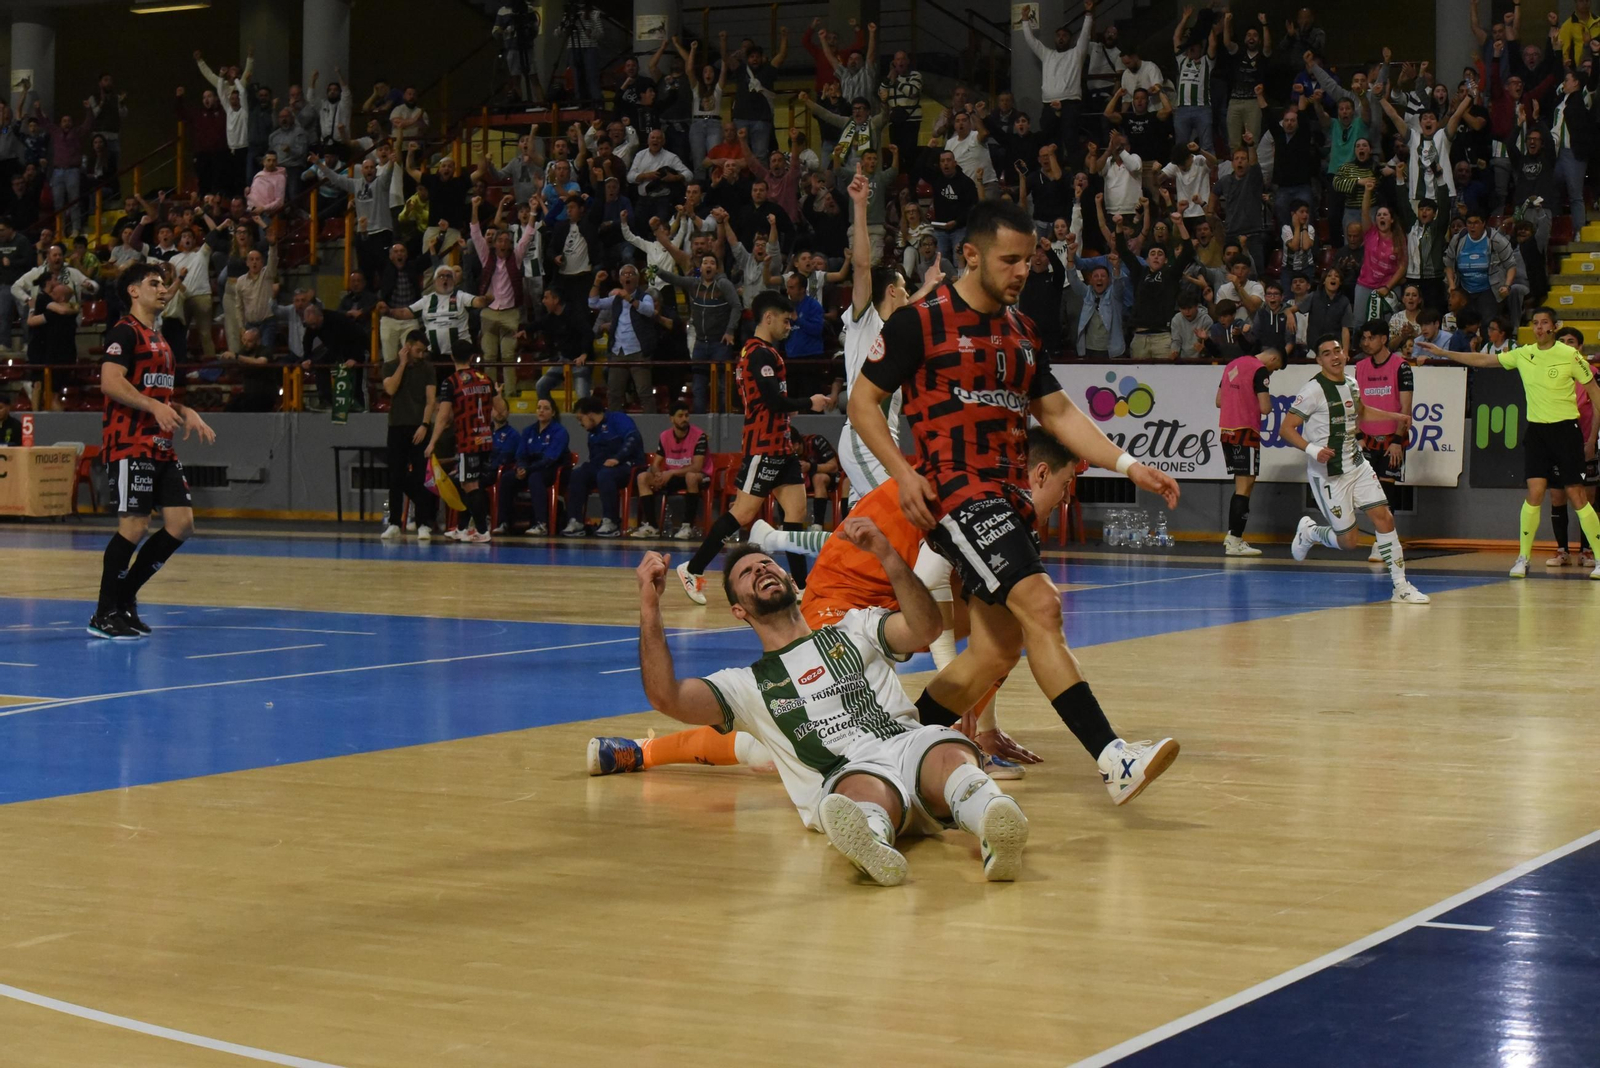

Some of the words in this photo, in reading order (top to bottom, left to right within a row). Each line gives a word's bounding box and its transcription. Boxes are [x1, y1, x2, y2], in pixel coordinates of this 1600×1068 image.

[996, 351, 1008, 382] 9
[477, 397, 486, 423] 4
[22, 416, 34, 435] 5
[1440, 443, 1456, 452] S.L.
[1324, 484, 1333, 500] 7
[976, 519, 1016, 550] Natural
[811, 680, 866, 702] HUMANIDAD
